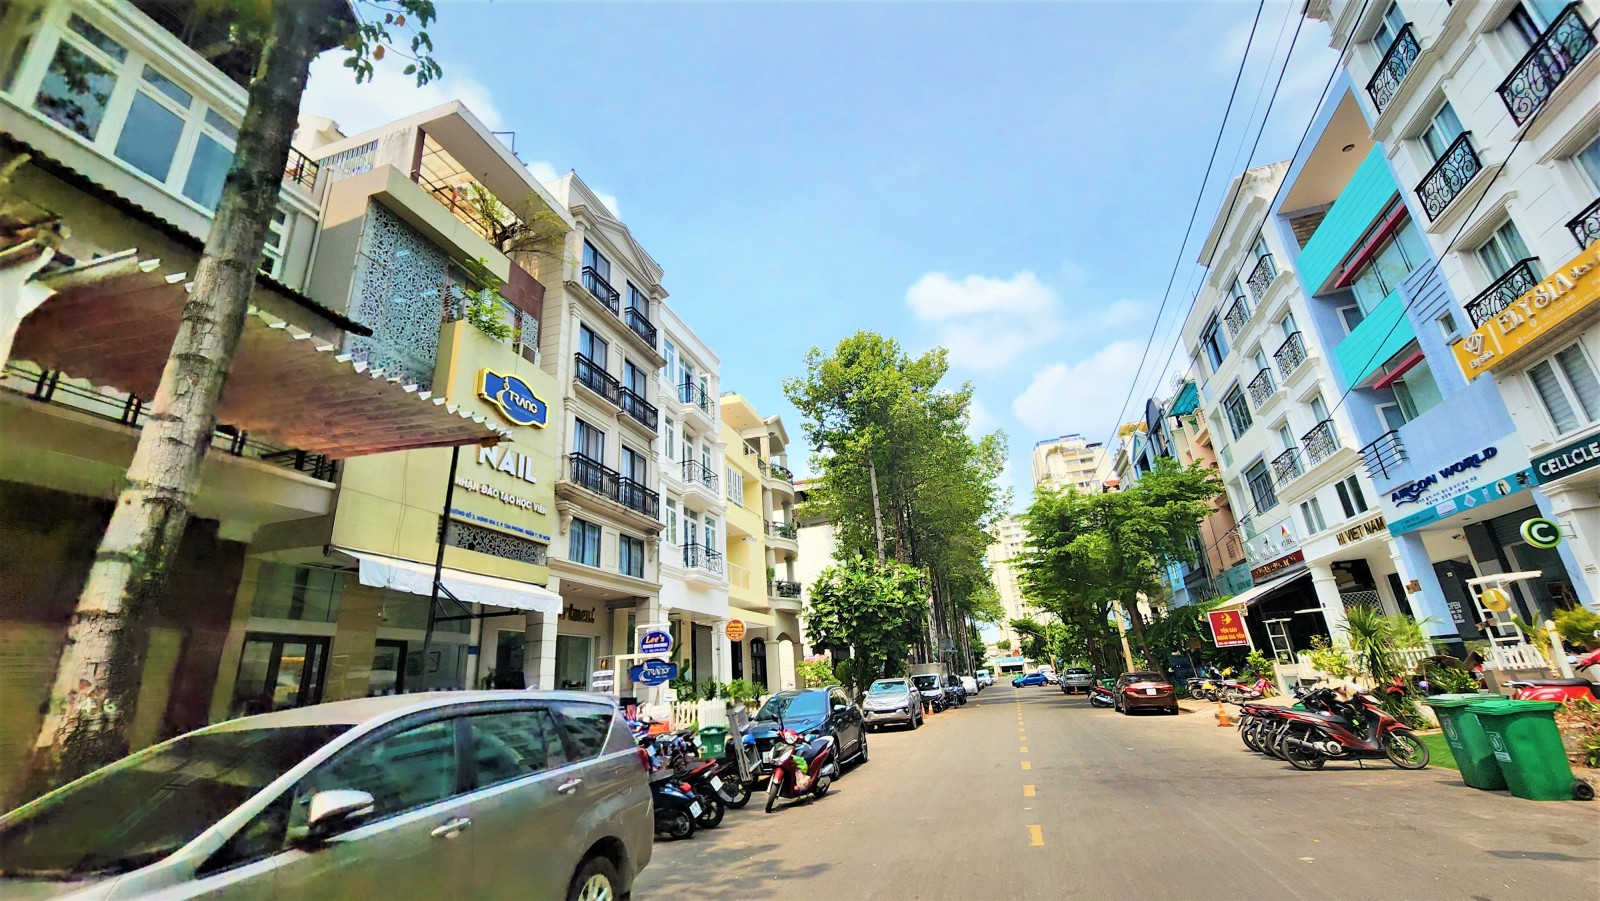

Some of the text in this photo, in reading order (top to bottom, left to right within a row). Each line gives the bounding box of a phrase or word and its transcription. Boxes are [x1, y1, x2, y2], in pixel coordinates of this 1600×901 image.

[1497, 272, 1576, 336] ELYSIA
[508, 390, 538, 415] TRANG
[477, 446, 537, 484] NAIL
[1439, 447, 1498, 479] WORLD
[455, 476, 479, 491] NHẬN
[481, 484, 499, 498] ĐÀO
[500, 491, 516, 505] TẠO
[516, 498, 532, 510] HỌC
[1336, 532, 1346, 546] HI
[1346, 526, 1364, 542] VIET
[1365, 516, 1387, 535] NAM
[1531, 523, 1556, 543] C
[645, 633, 666, 644] Lee's
